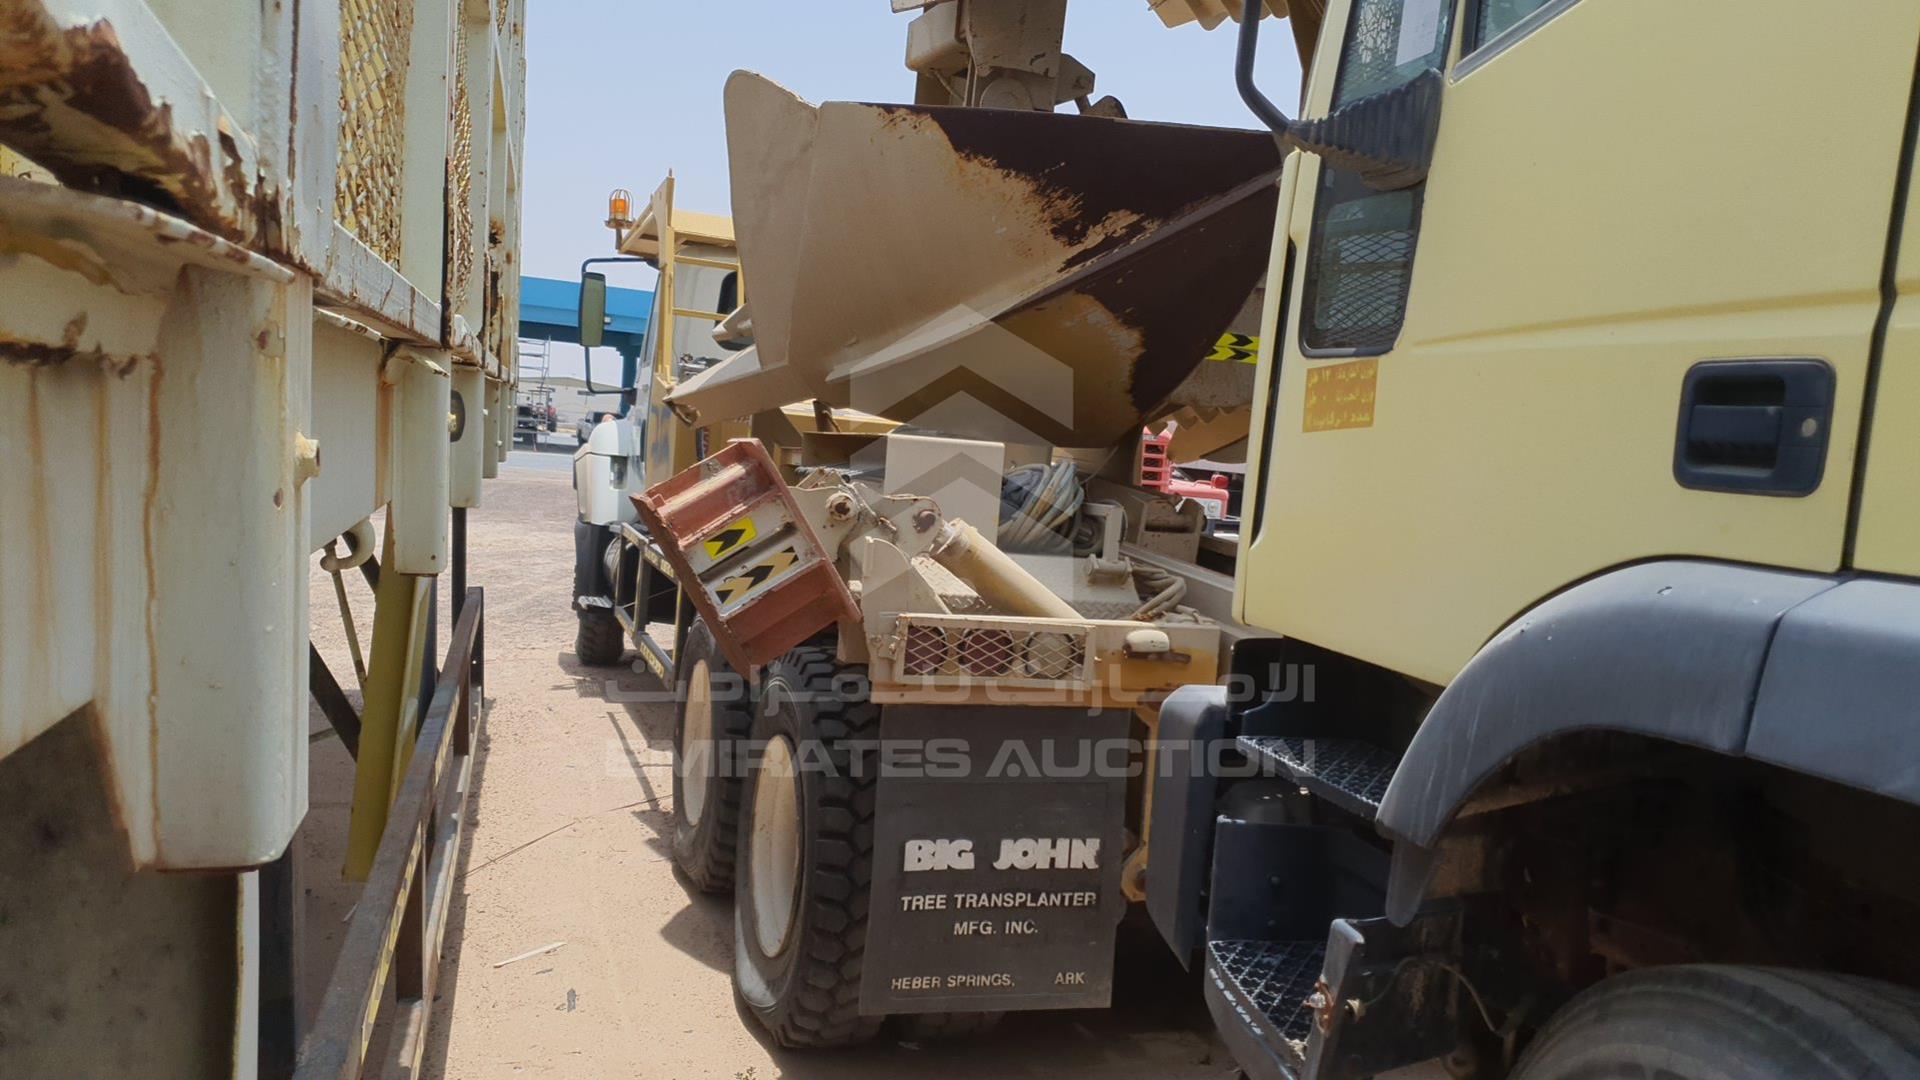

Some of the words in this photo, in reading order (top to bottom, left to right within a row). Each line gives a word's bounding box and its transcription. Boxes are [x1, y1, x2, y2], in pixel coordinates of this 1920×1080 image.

[902, 839, 975, 872] BIG
[992, 838, 1101, 871] JOHN
[901, 894, 947, 911] TREE
[954, 891, 1097, 910] TRANSPLANTER
[953, 920, 997, 936] MFG.
[1005, 919, 1039, 935] INC.
[891, 976, 941, 990] HEBER
[1054, 971, 1086, 985] ARK
